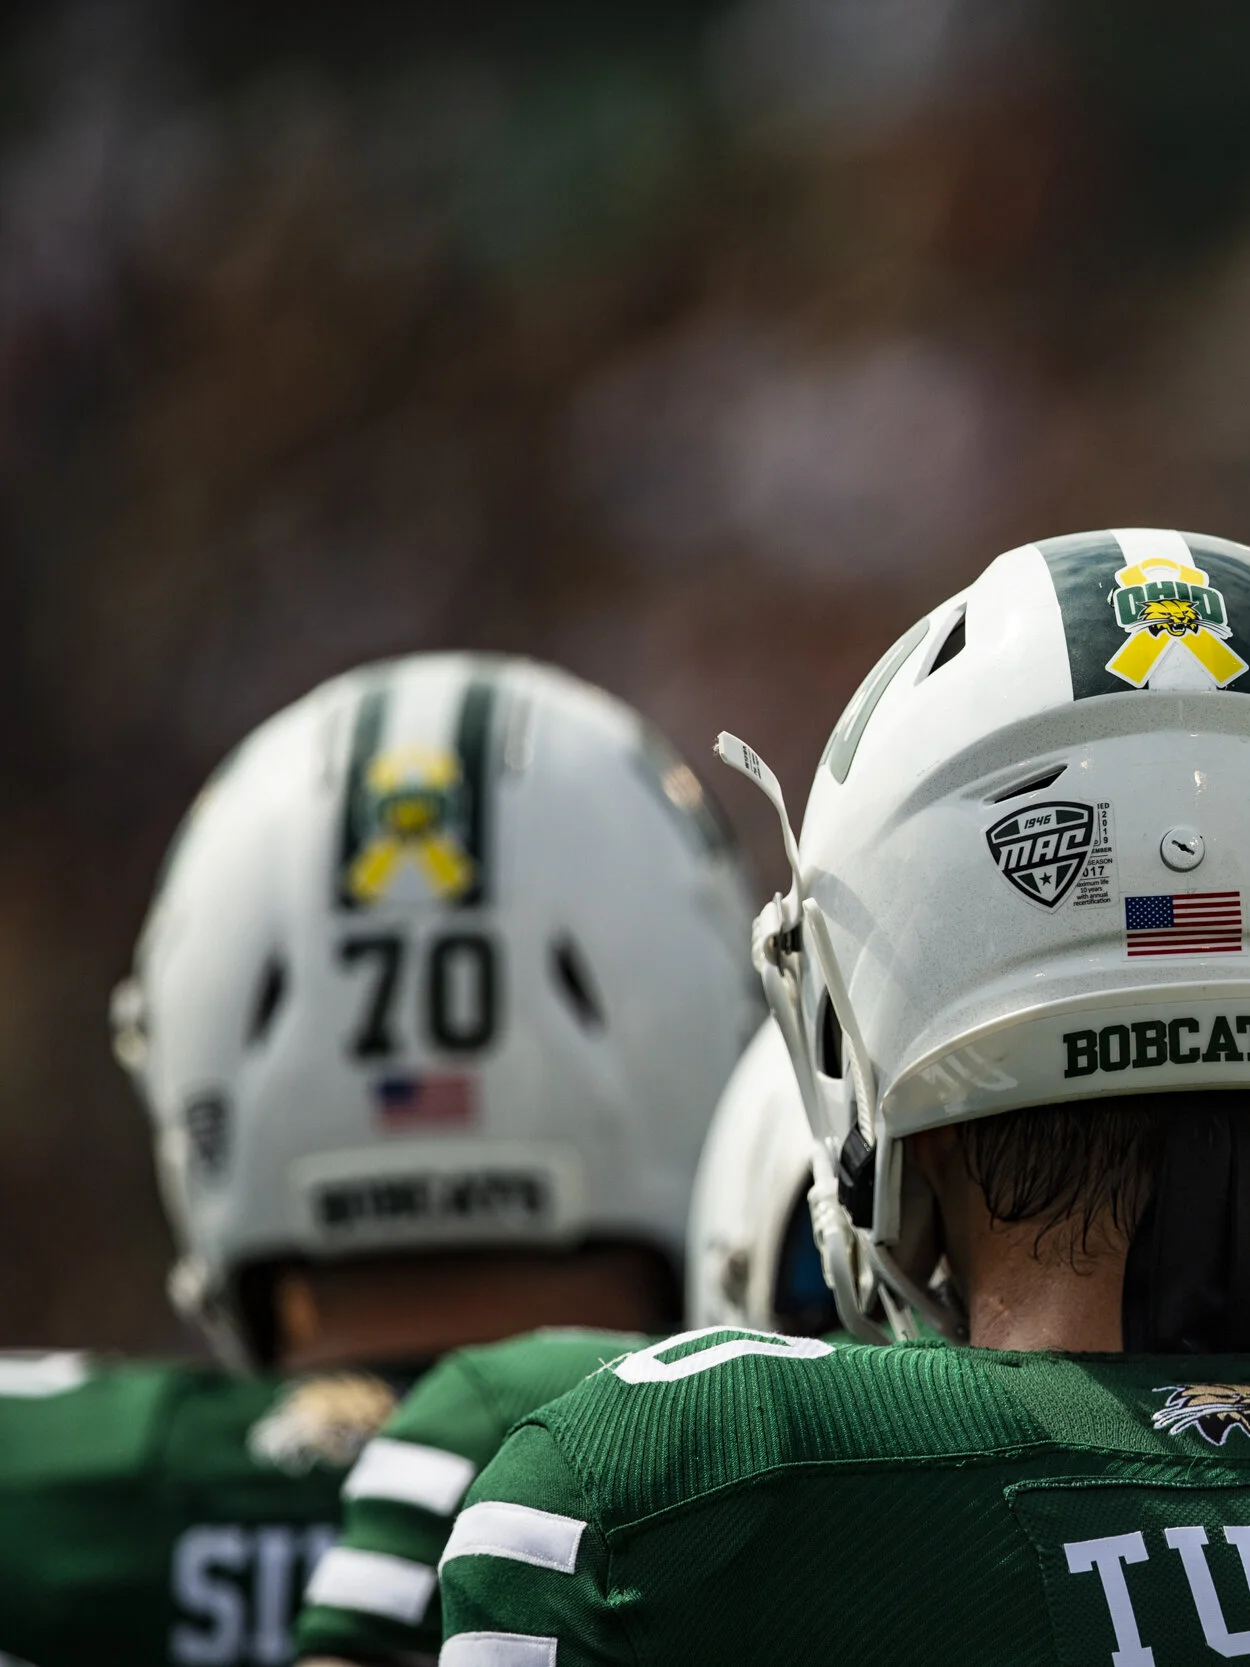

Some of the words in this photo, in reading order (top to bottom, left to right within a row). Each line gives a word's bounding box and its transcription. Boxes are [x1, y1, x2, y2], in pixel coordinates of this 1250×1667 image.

[1116, 580, 1225, 627] OHIO
[1024, 814, 1052, 829] 1946
[999, 827, 1089, 871] MAC
[1082, 866, 1105, 878] 017
[1088, 887, 1103, 895] years
[337, 929, 504, 1060] 70
[172, 1522, 340, 1667] SI
